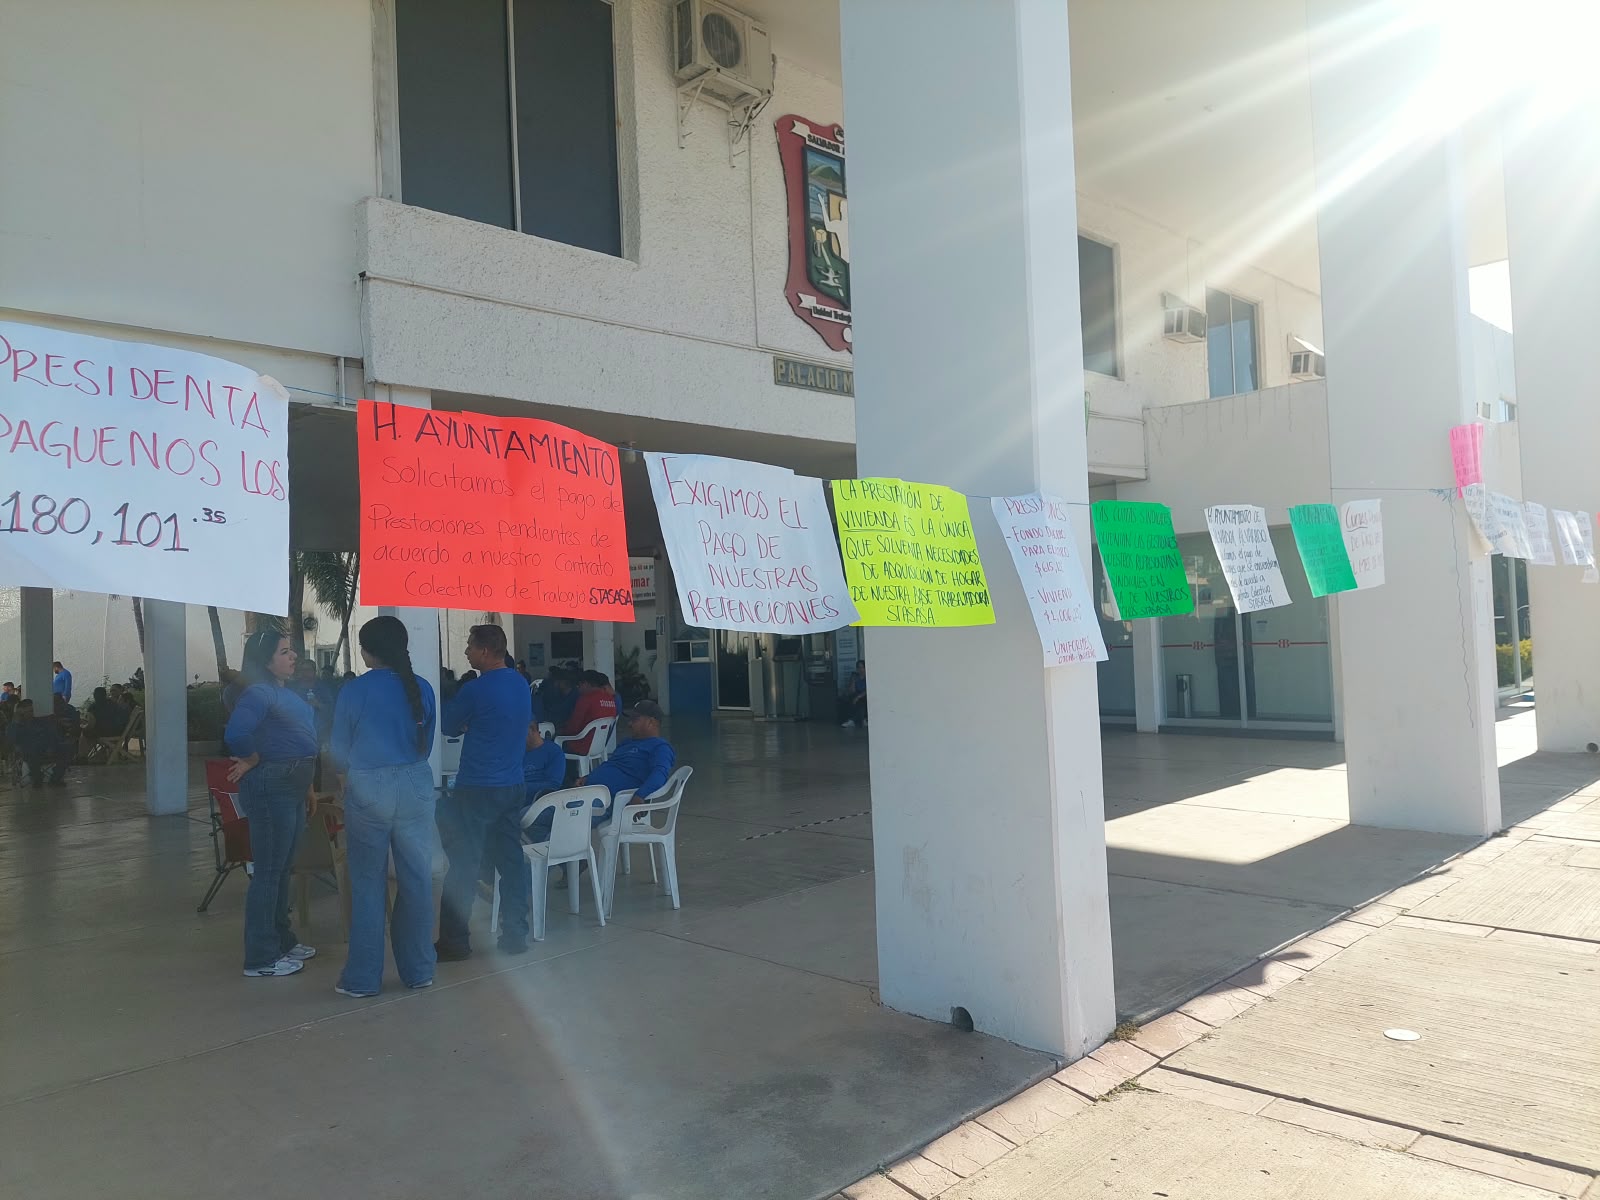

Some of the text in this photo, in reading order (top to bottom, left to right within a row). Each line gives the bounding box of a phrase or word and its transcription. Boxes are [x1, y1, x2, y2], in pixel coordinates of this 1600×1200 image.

[777, 359, 838, 391] PALACIO
[373, 401, 615, 486] H. AYUNTAMIENTO
[241, 450, 286, 501] LOS
[381, 455, 622, 520] Solicitamos el pago de
[661, 456, 808, 530] EXIGIMOS EL
[839, 479, 857, 501] LA
[929, 493, 945, 512] DE
[367, 503, 612, 550] Prestaciones pendientes de
[840, 510, 900, 532] VIVIENDA
[921, 517, 936, 538] LA
[1011, 525, 1043, 543] FONDO
[698, 519, 782, 563] PAGO DE
[845, 536, 874, 561] QUE
[1021, 544, 1046, 557] PARA
[373, 541, 614, 577] acuerdo a nuestro Contrato
[861, 562, 879, 581] DE
[935, 569, 948, 586] DE
[951, 570, 985, 588] HOGAR
[404, 570, 633, 609] Colectivo de Trabajo STASASA
[707, 563, 818, 593] NUESTRAS
[688, 589, 840, 625] RETENCIONES
[851, 585, 869, 603] DE
[871, 585, 911, 605] NUESTRA
[1144, 587, 1189, 606] NUESTROS
[886, 605, 936, 625] STASASA
